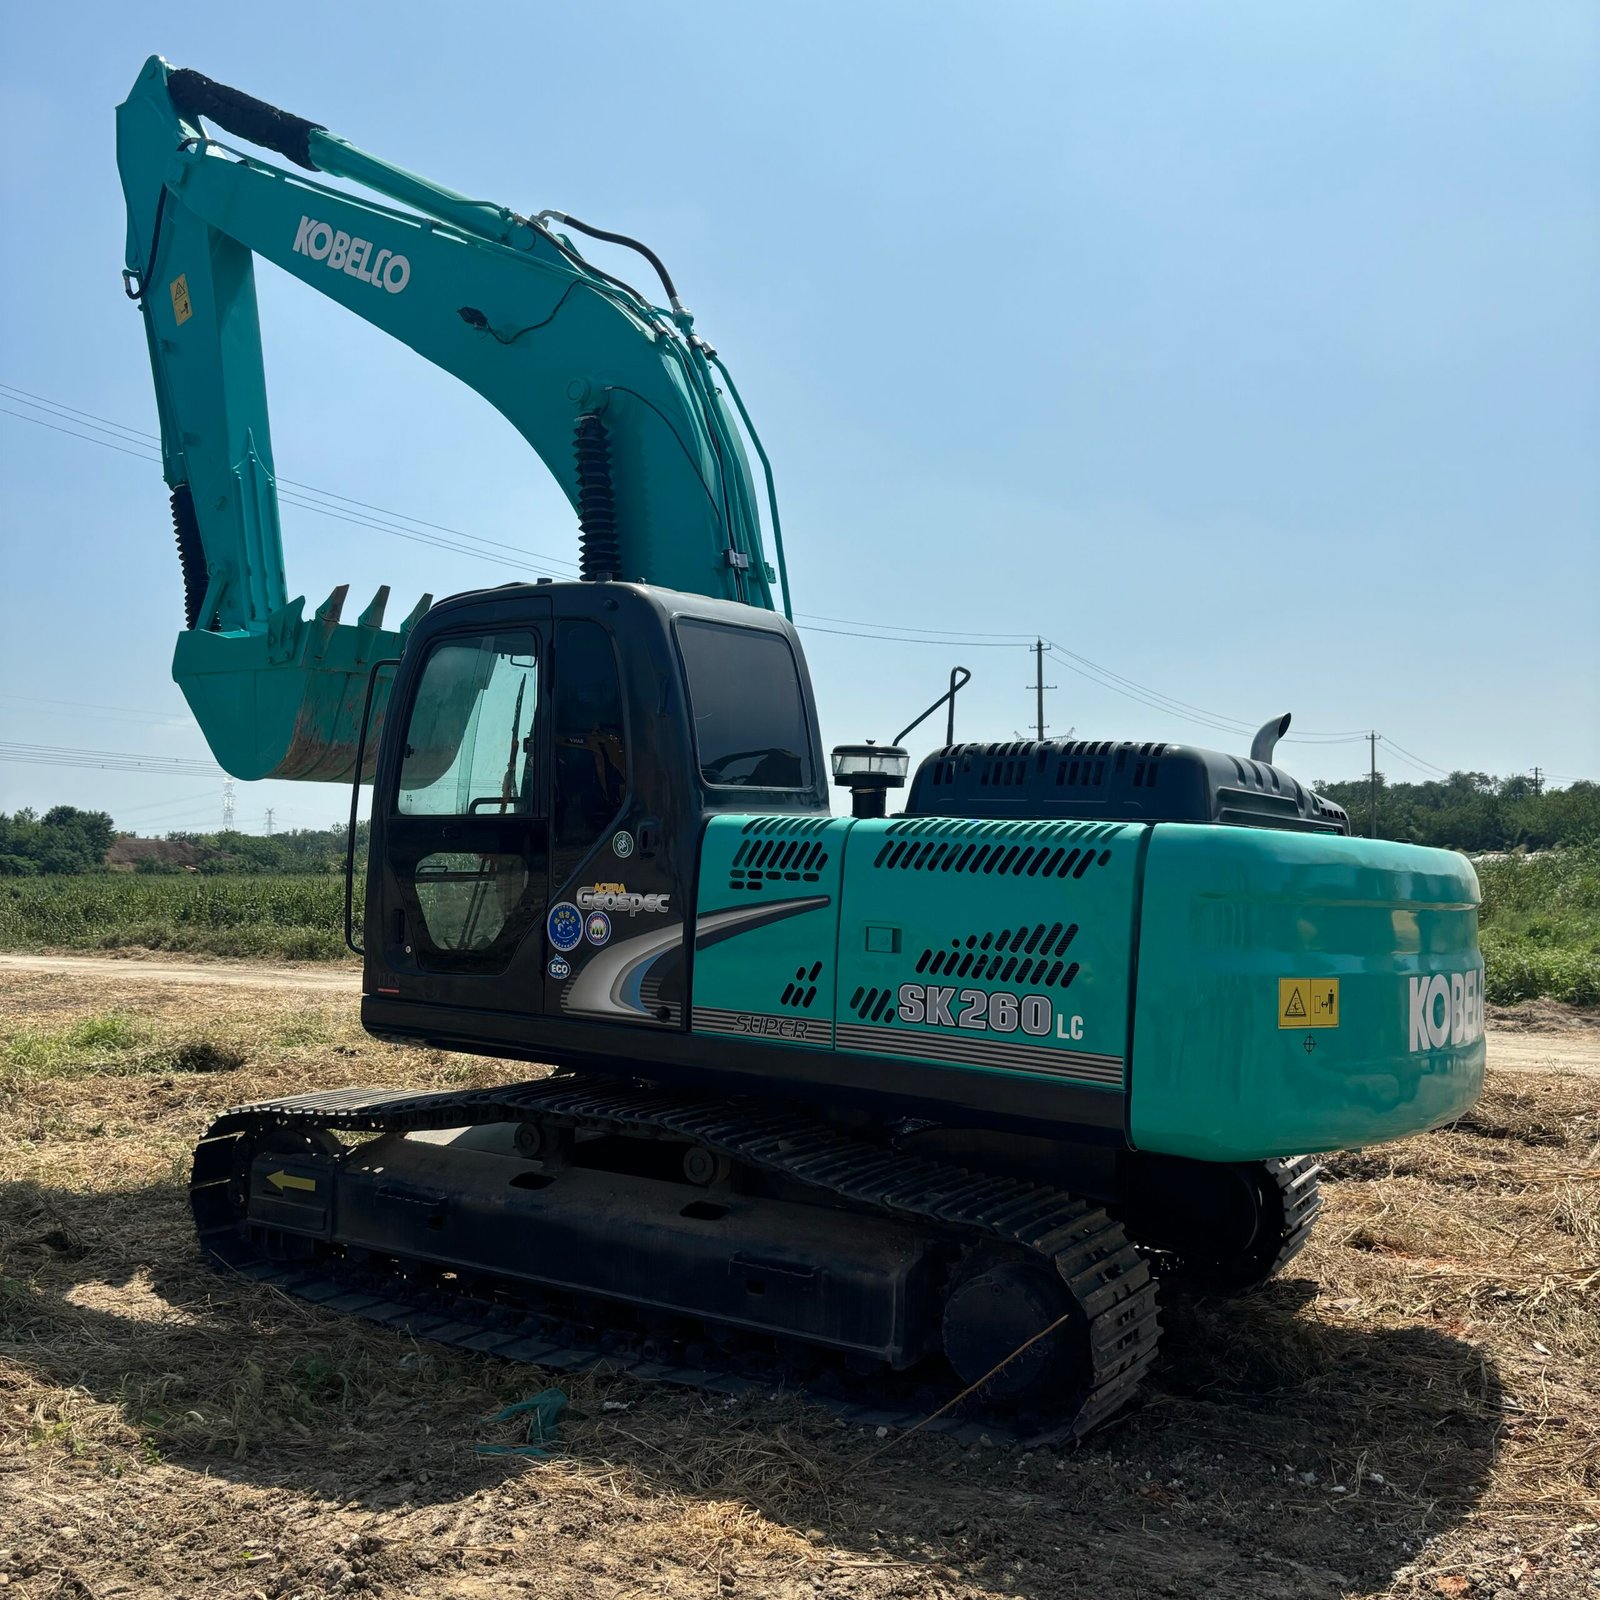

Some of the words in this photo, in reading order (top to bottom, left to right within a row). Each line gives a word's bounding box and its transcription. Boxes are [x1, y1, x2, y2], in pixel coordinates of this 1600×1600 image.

[292, 215, 411, 294] KOBELCO
[551, 964, 568, 974] ECO
[734, 1014, 809, 1040] SUPER
[897, 983, 1053, 1036] SK260
[1056, 1014, 1084, 1040] LC
